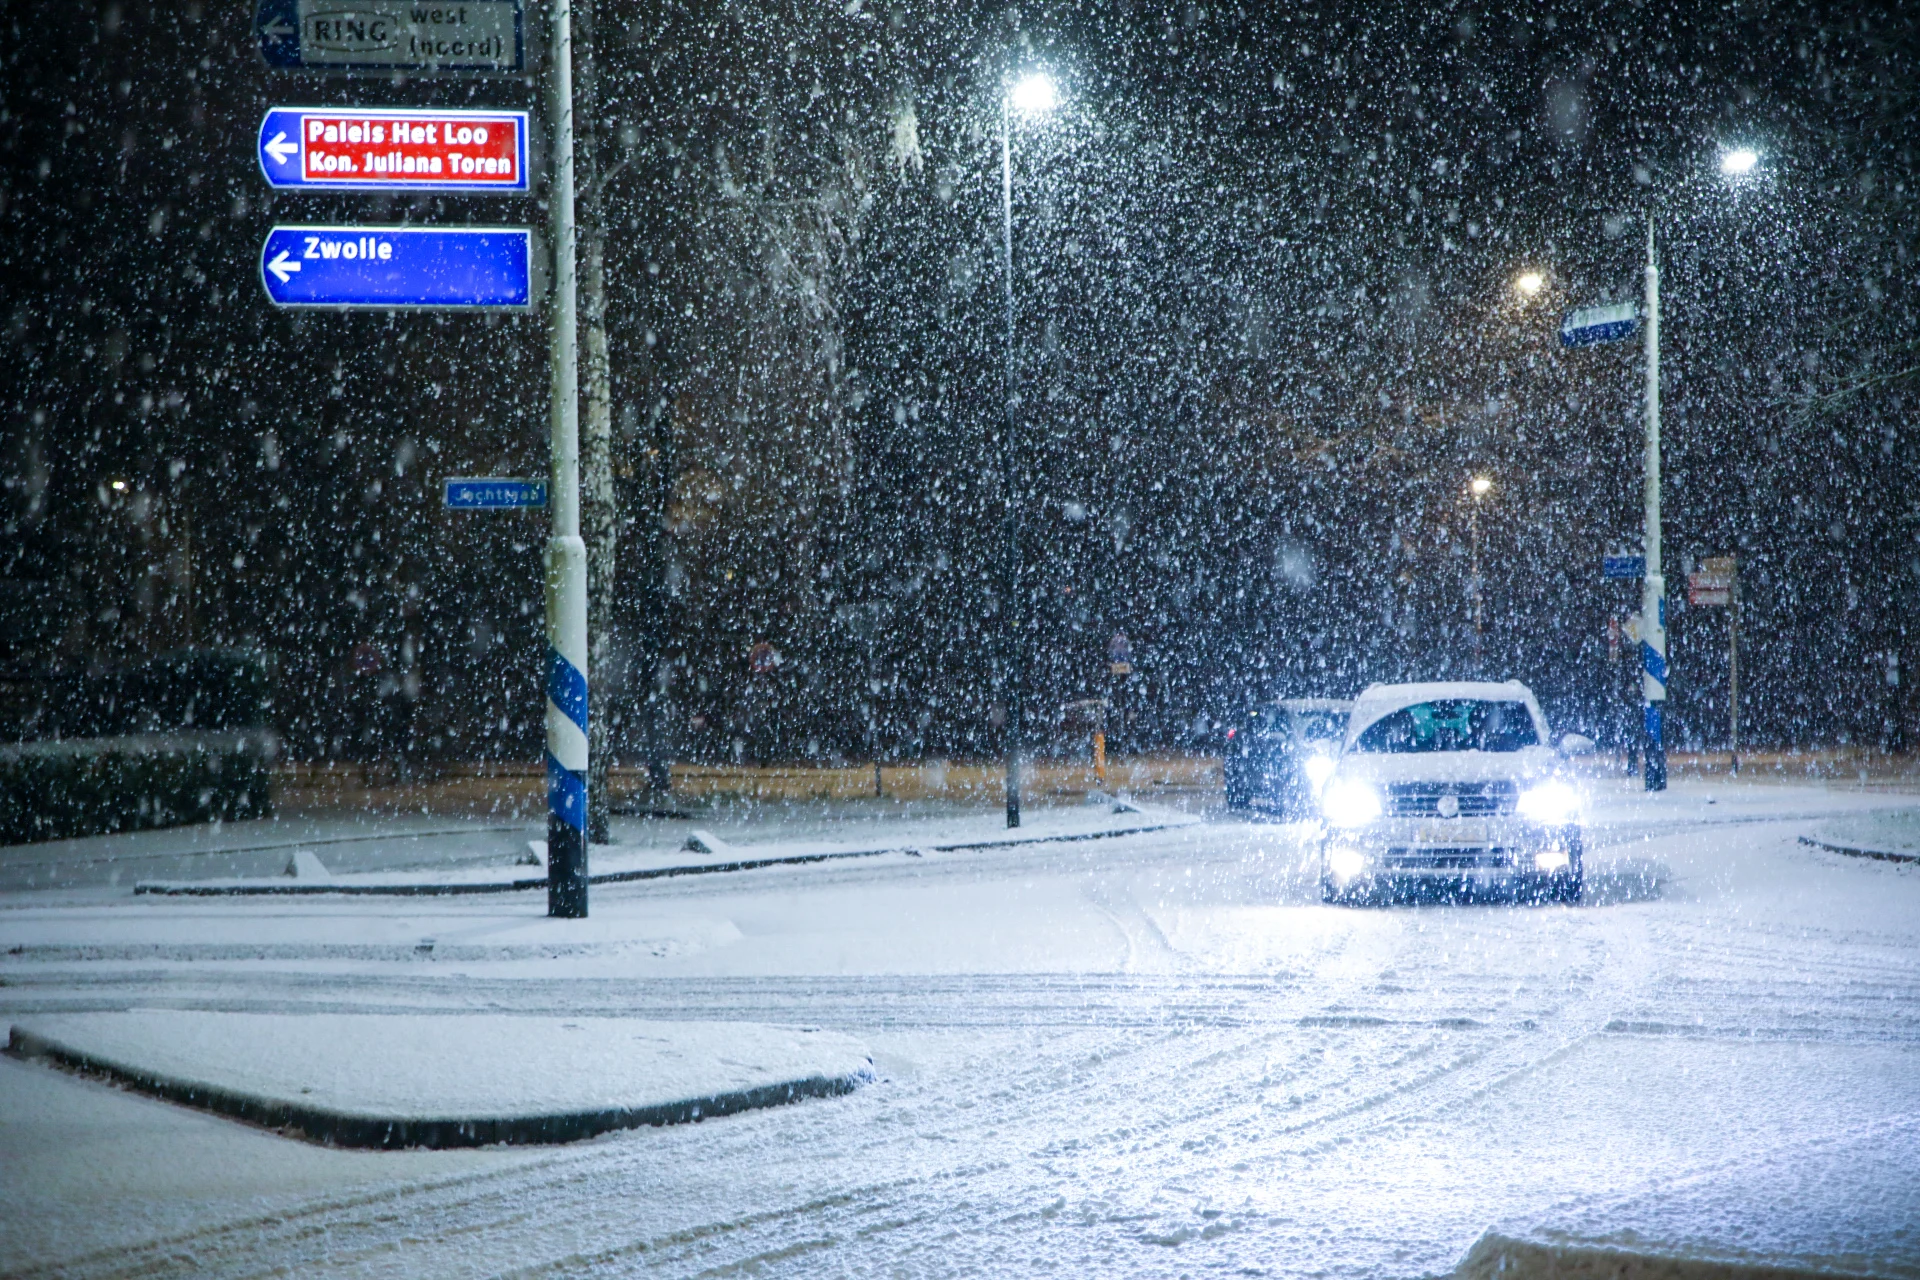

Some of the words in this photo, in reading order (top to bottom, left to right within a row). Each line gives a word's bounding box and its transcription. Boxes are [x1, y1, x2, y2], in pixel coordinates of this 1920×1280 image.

[409, 6, 467, 24] west
[315, 20, 387, 42] RING
[410, 36, 501, 59] (noord)
[309, 120, 385, 143] Paleis
[392, 122, 437, 144] Het
[444, 123, 489, 144] Loo
[309, 151, 359, 173] Kon.
[363, 151, 443, 173] Juliana
[448, 153, 511, 174] Toren
[303, 236, 393, 260] Zwolle
